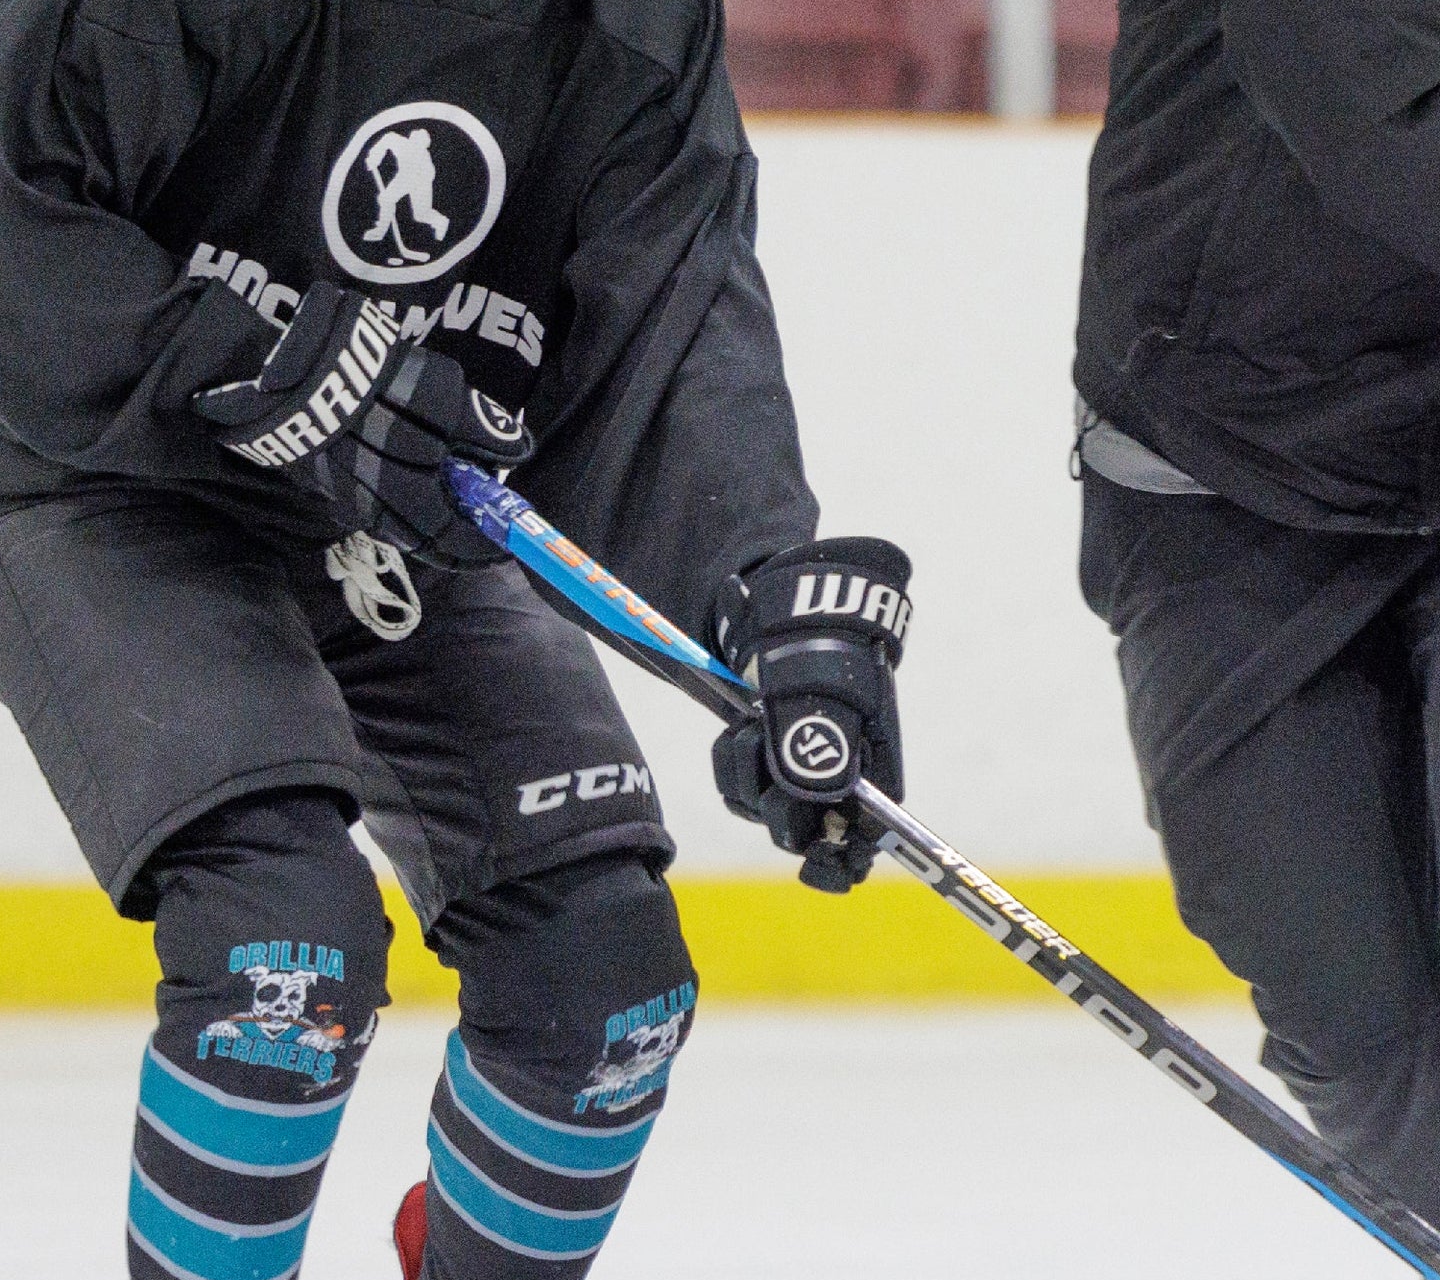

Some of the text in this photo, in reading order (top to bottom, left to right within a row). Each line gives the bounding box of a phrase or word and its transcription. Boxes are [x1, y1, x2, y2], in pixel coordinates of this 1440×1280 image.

[517, 762, 652, 816] CCM
[228, 939, 345, 983] ORILLIA
[196, 1031, 337, 1084] TERRIERS
